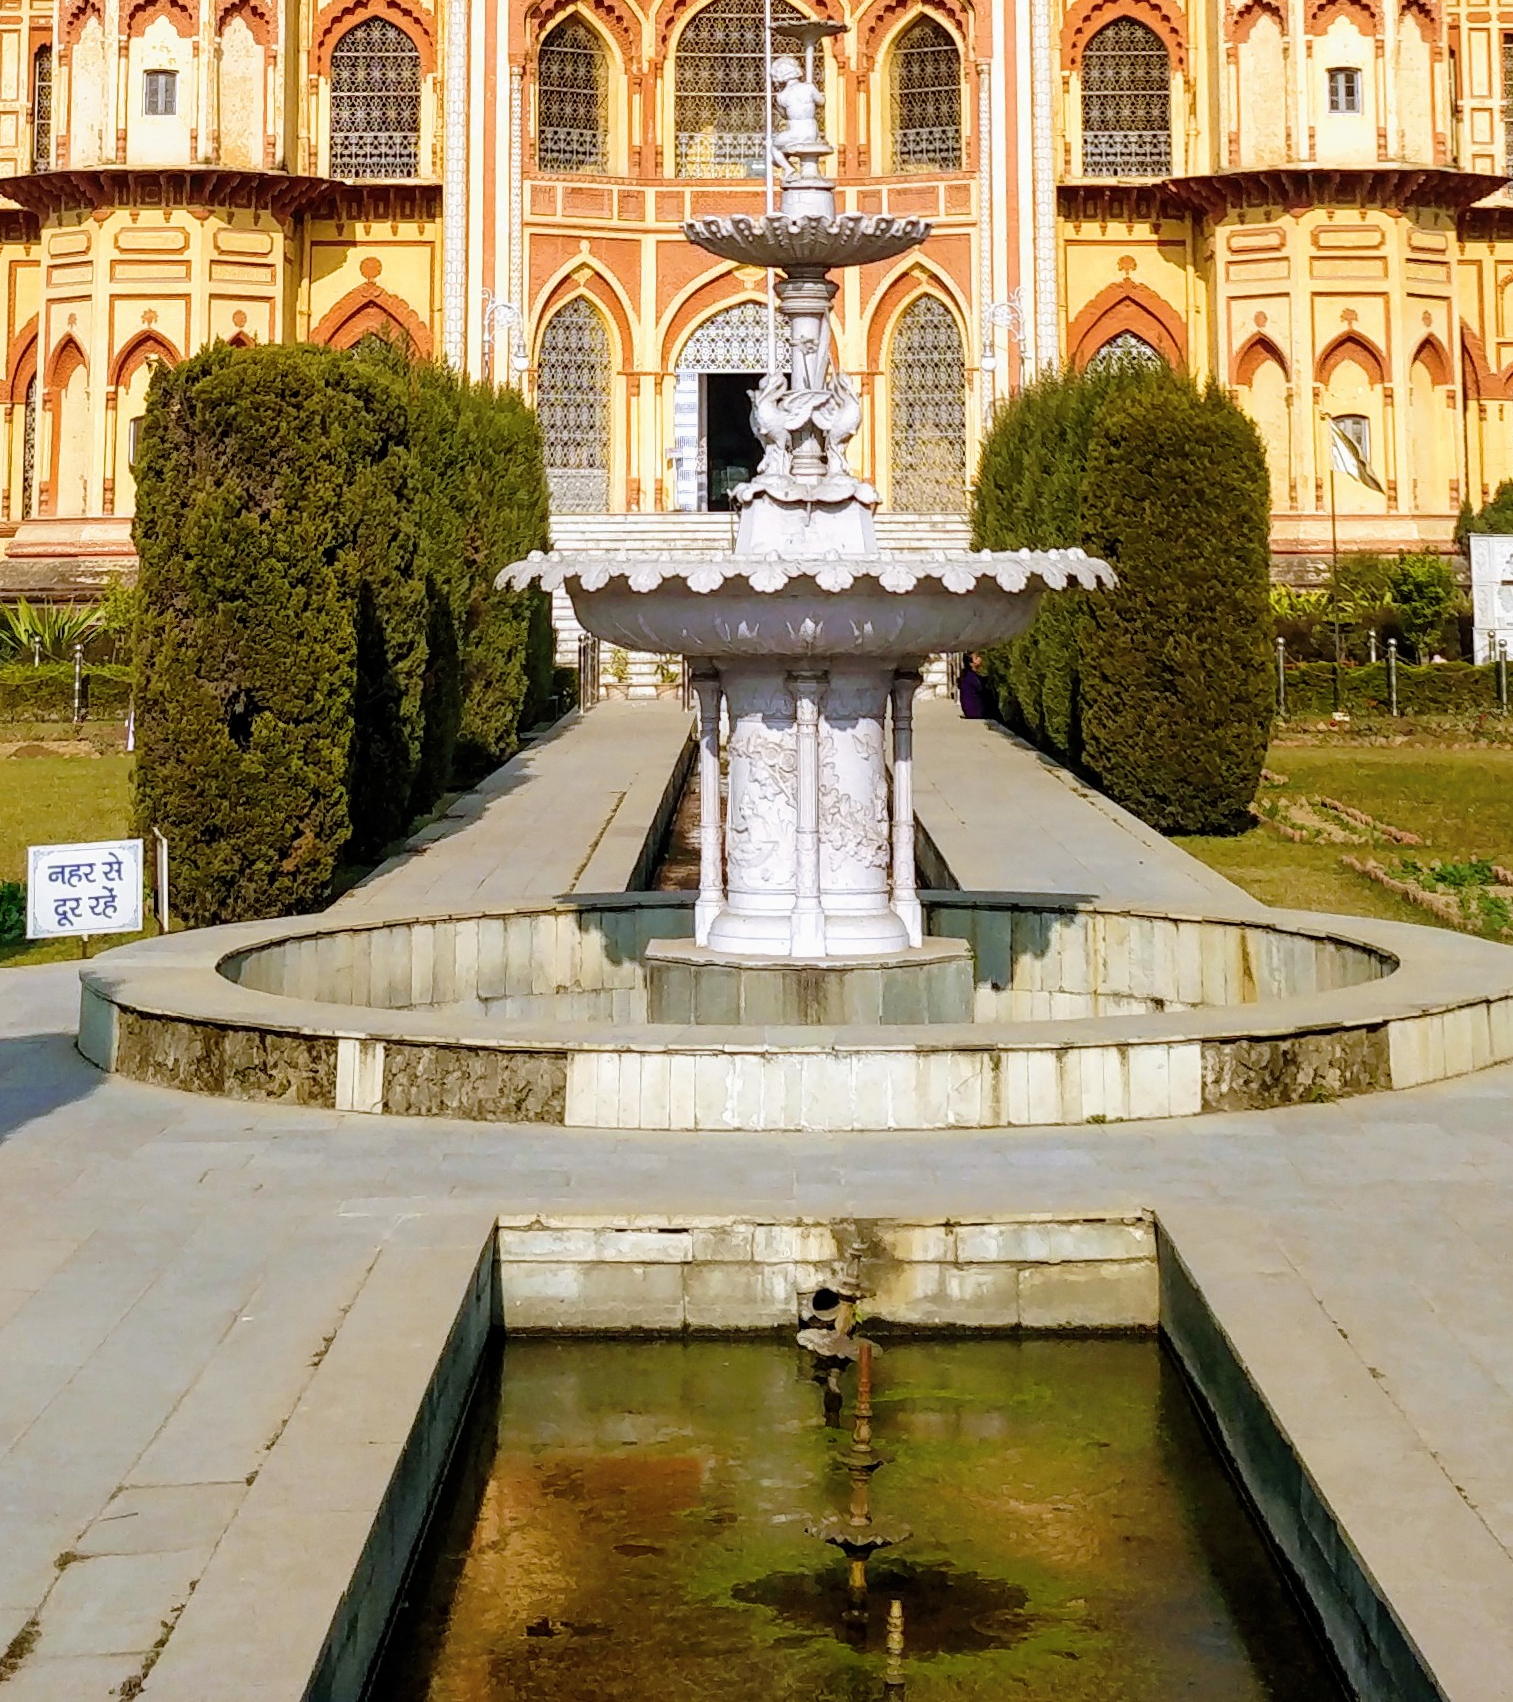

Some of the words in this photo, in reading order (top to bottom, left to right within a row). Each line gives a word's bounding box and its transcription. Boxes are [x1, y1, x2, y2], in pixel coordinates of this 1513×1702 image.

[47, 862, 96, 887] नहर
[101, 852, 124, 881] से
[53, 897, 83, 926] दूर
[87, 886, 118, 919] रहें
